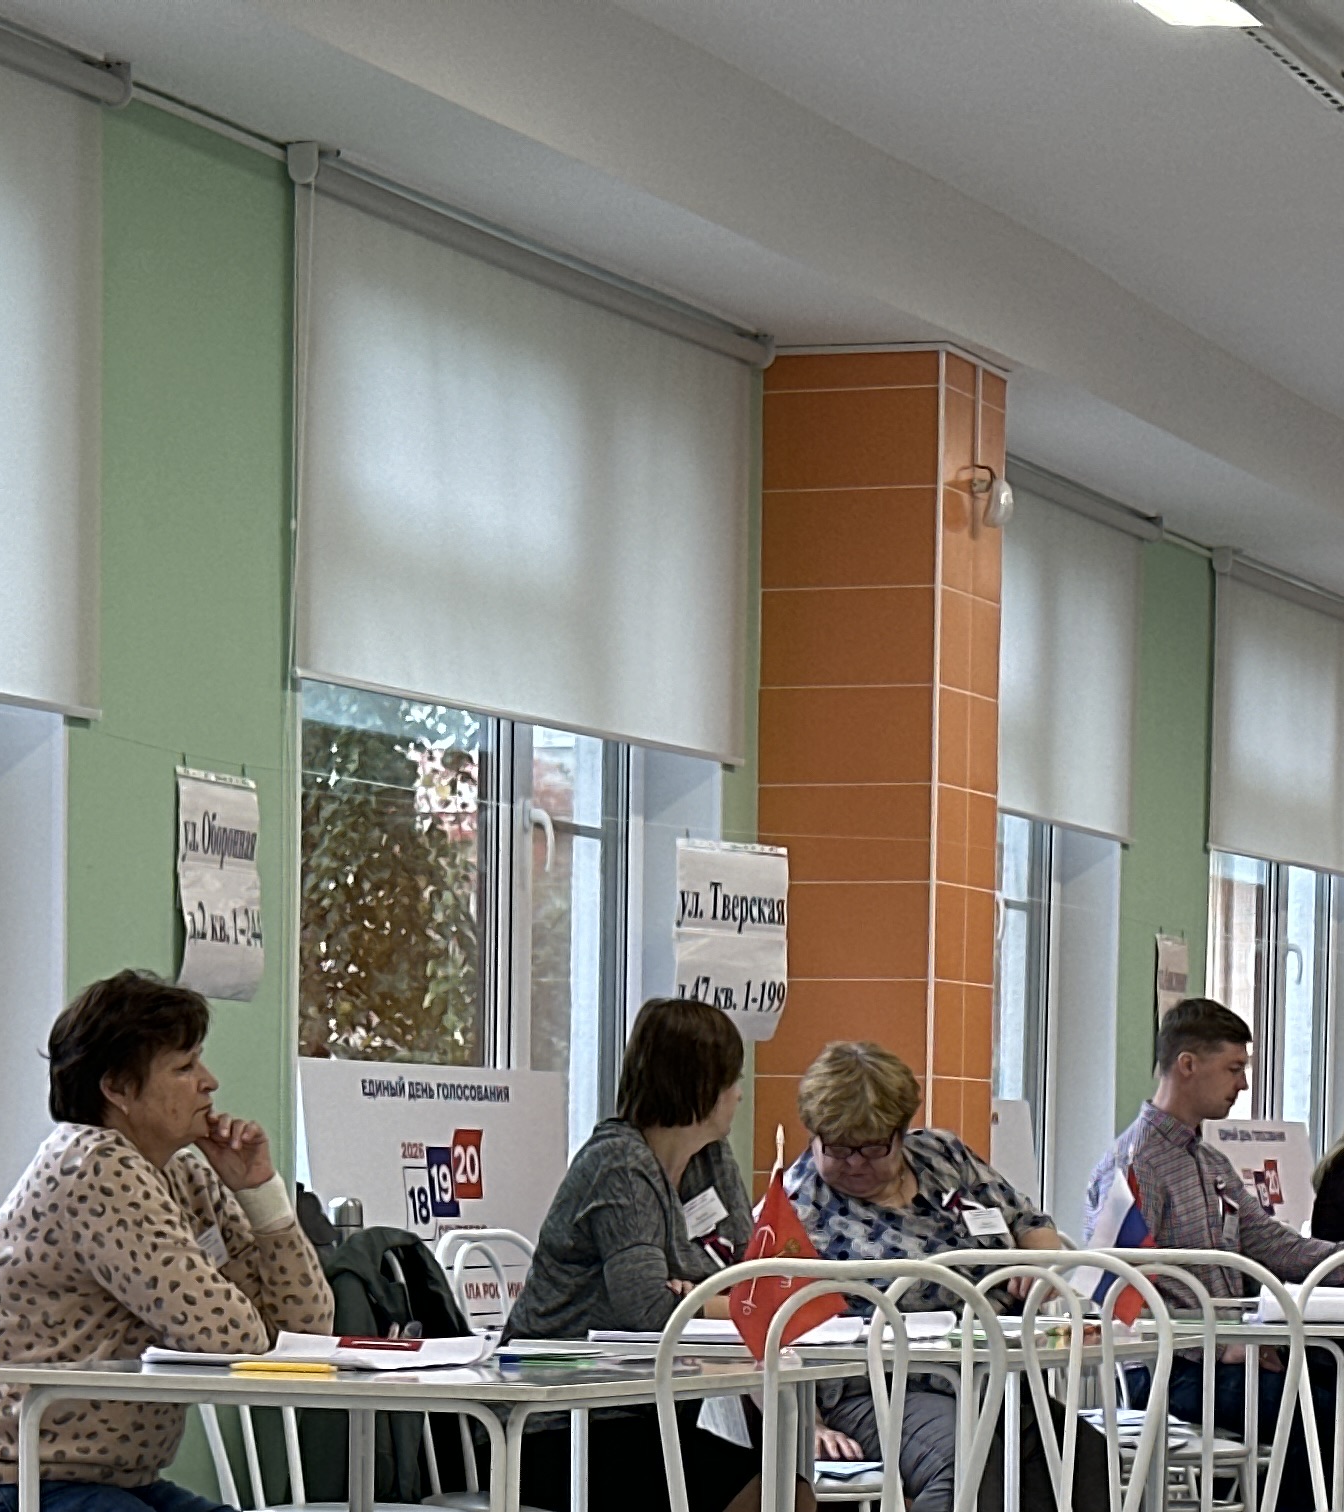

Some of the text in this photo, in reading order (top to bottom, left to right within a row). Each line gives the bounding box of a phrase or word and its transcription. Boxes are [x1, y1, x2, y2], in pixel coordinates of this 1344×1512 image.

[181, 810, 258, 870] ул. Оборонная
[676, 881, 786, 934] ул. Тверская
[210, 913, 230, 945] кв.
[714, 986, 737, 1011] кв.
[742, 979, 786, 1013] 1-199
[361, 1076, 510, 1103] ЕДИНЫЙ ДЕНЬ ГОЛОСОВАНИЯ
[401, 1142, 425, 1160] 2026
[408, 1145, 480, 1226] 18 19 20
